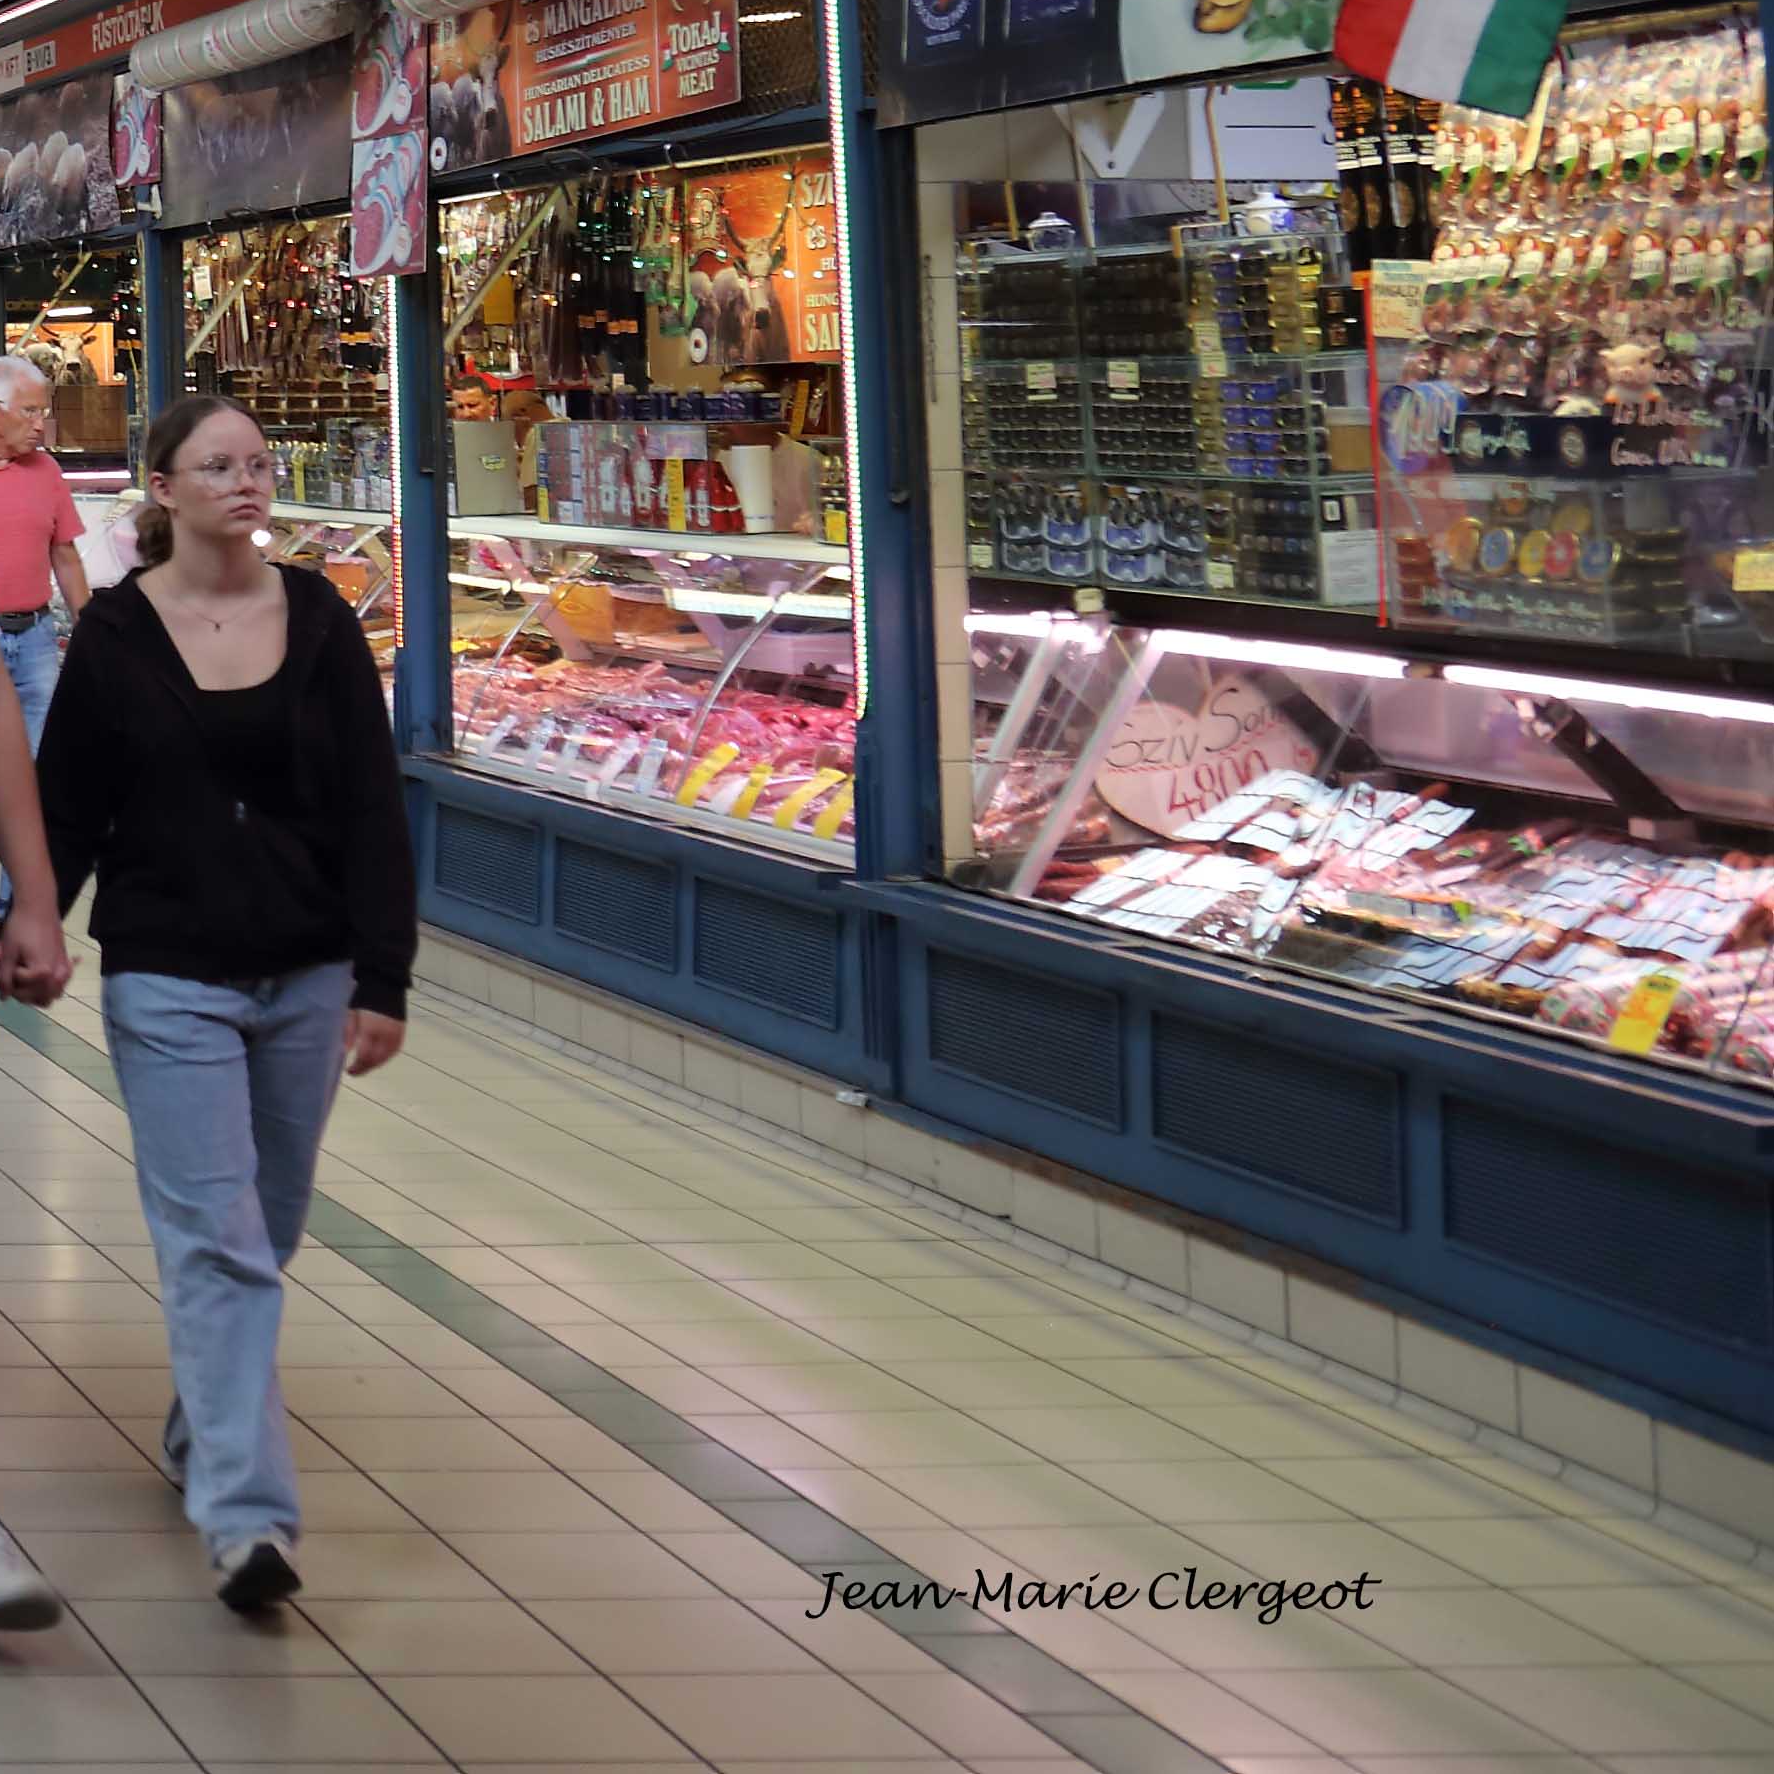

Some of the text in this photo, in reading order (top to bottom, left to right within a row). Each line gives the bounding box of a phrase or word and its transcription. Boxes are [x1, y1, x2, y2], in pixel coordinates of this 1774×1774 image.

[667, 10, 722, 56] TOKAJ
[524, 72, 583, 101] HUNGARIAN
[677, 68, 717, 99] MEAT
[522, 75, 652, 145] SALAMI & HAM
